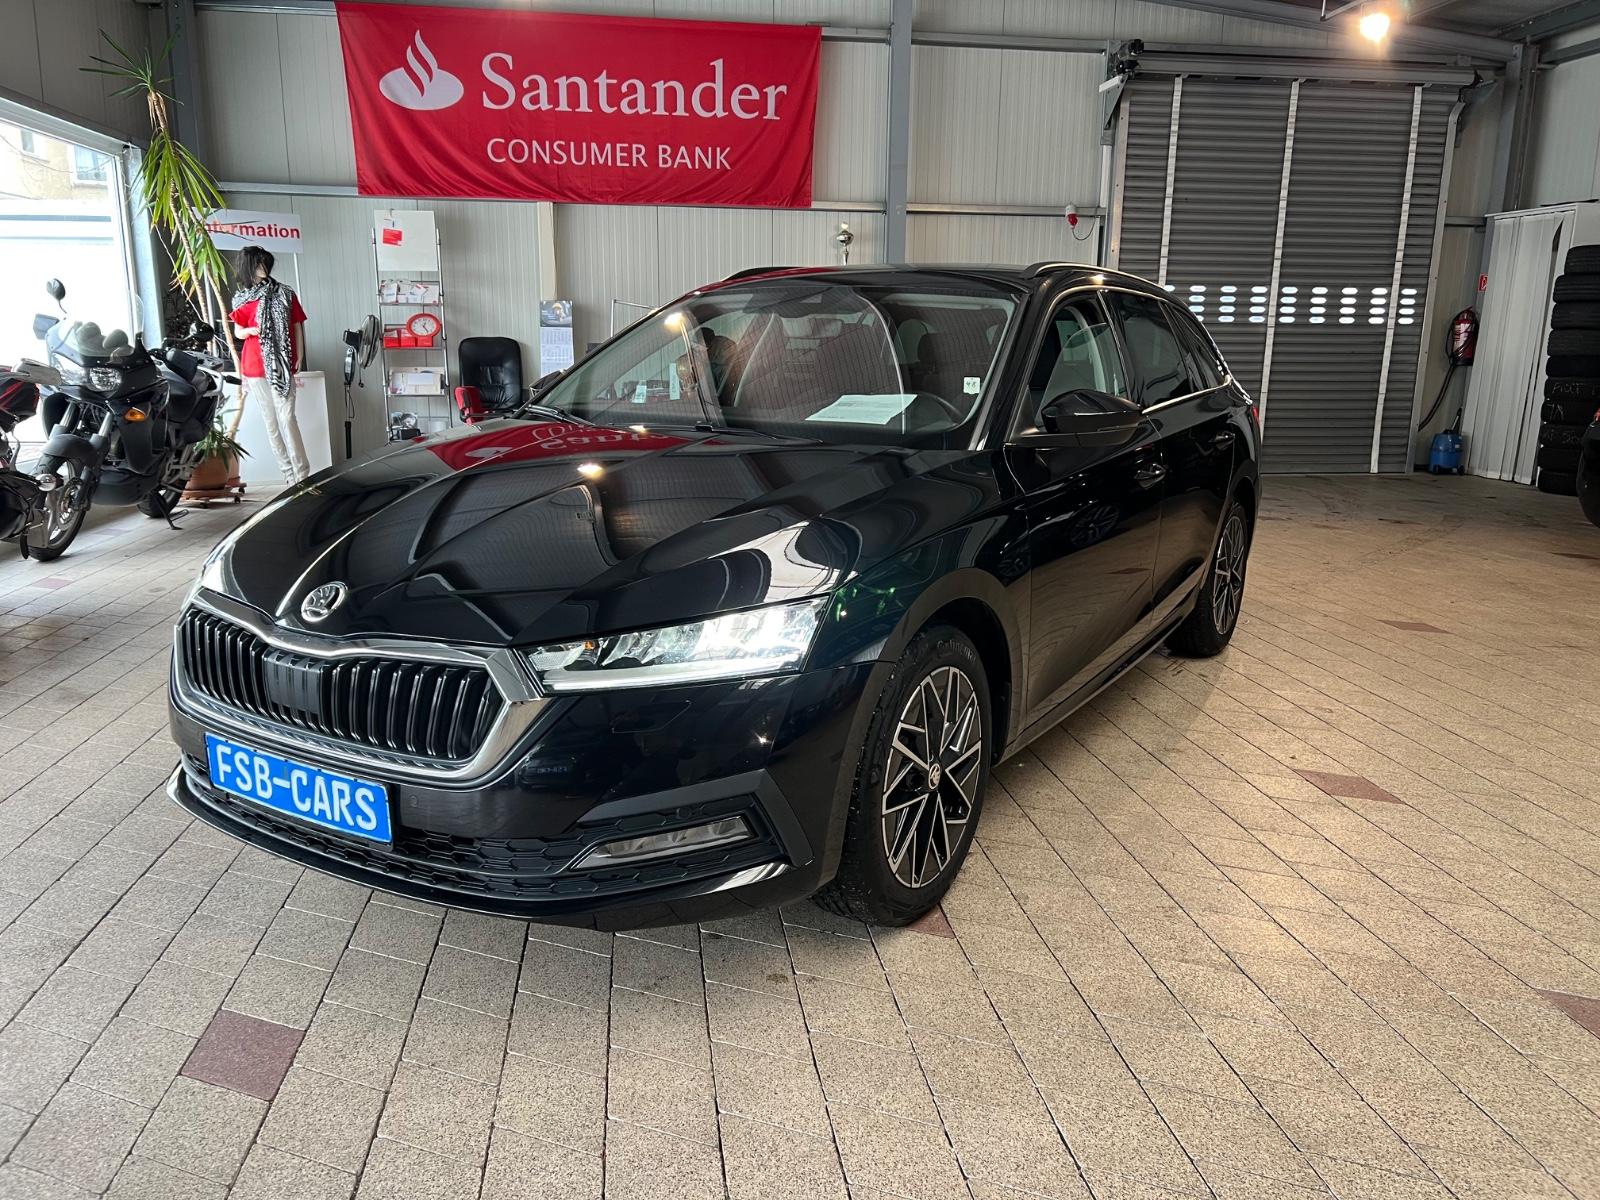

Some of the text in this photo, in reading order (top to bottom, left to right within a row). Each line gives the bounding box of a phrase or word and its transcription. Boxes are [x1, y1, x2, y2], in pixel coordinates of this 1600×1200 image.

[481, 52, 787, 120] Santander
[486, 138, 732, 170] CONSUMER BANK
[216, 744, 377, 831] FSB-CARS
